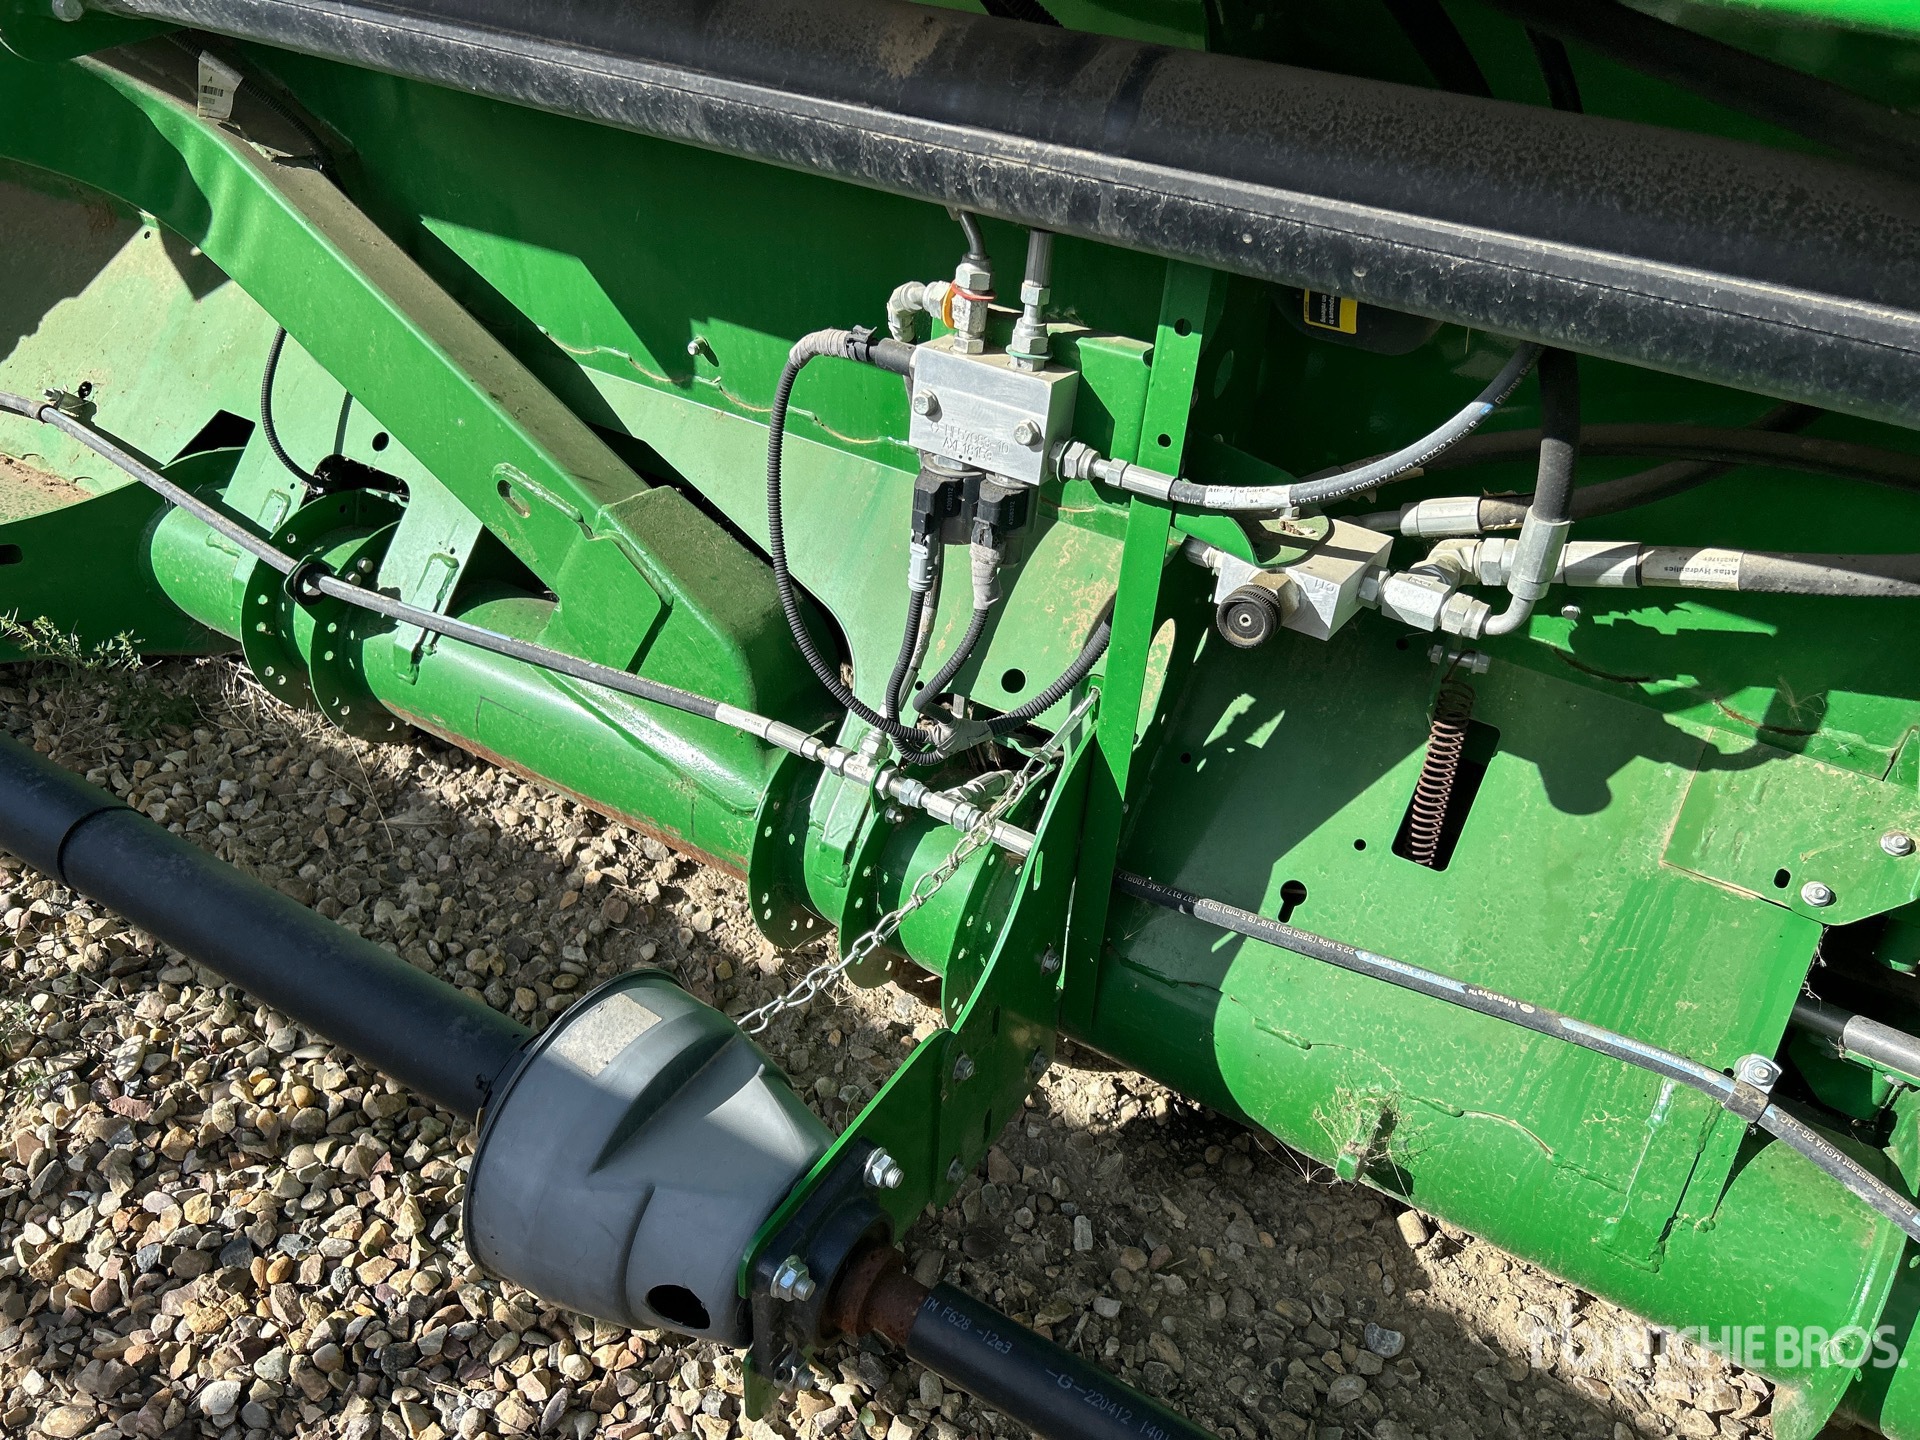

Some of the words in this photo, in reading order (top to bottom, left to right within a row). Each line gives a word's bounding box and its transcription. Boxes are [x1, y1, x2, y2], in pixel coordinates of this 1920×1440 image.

[1664, 565, 1711, 576] Hydraulics
[1118, 872, 1146, 887] 100R17
[1147, 882, 1161, 892] SAE
[1207, 902, 1221, 913] ISO
[1318, 938, 1335, 950] MPa
[1336, 944, 1355, 955] 22.5
[1780, 1115, 1814, 1142] 2G-11C
[1815, 1138, 1842, 1161] MSHA
[1843, 1158, 1886, 1194] Resistant
[1885, 1190, 1914, 1216] Flame
[940, 1308, 971, 1331] F628
[976, 1328, 1014, 1355] -12e3
